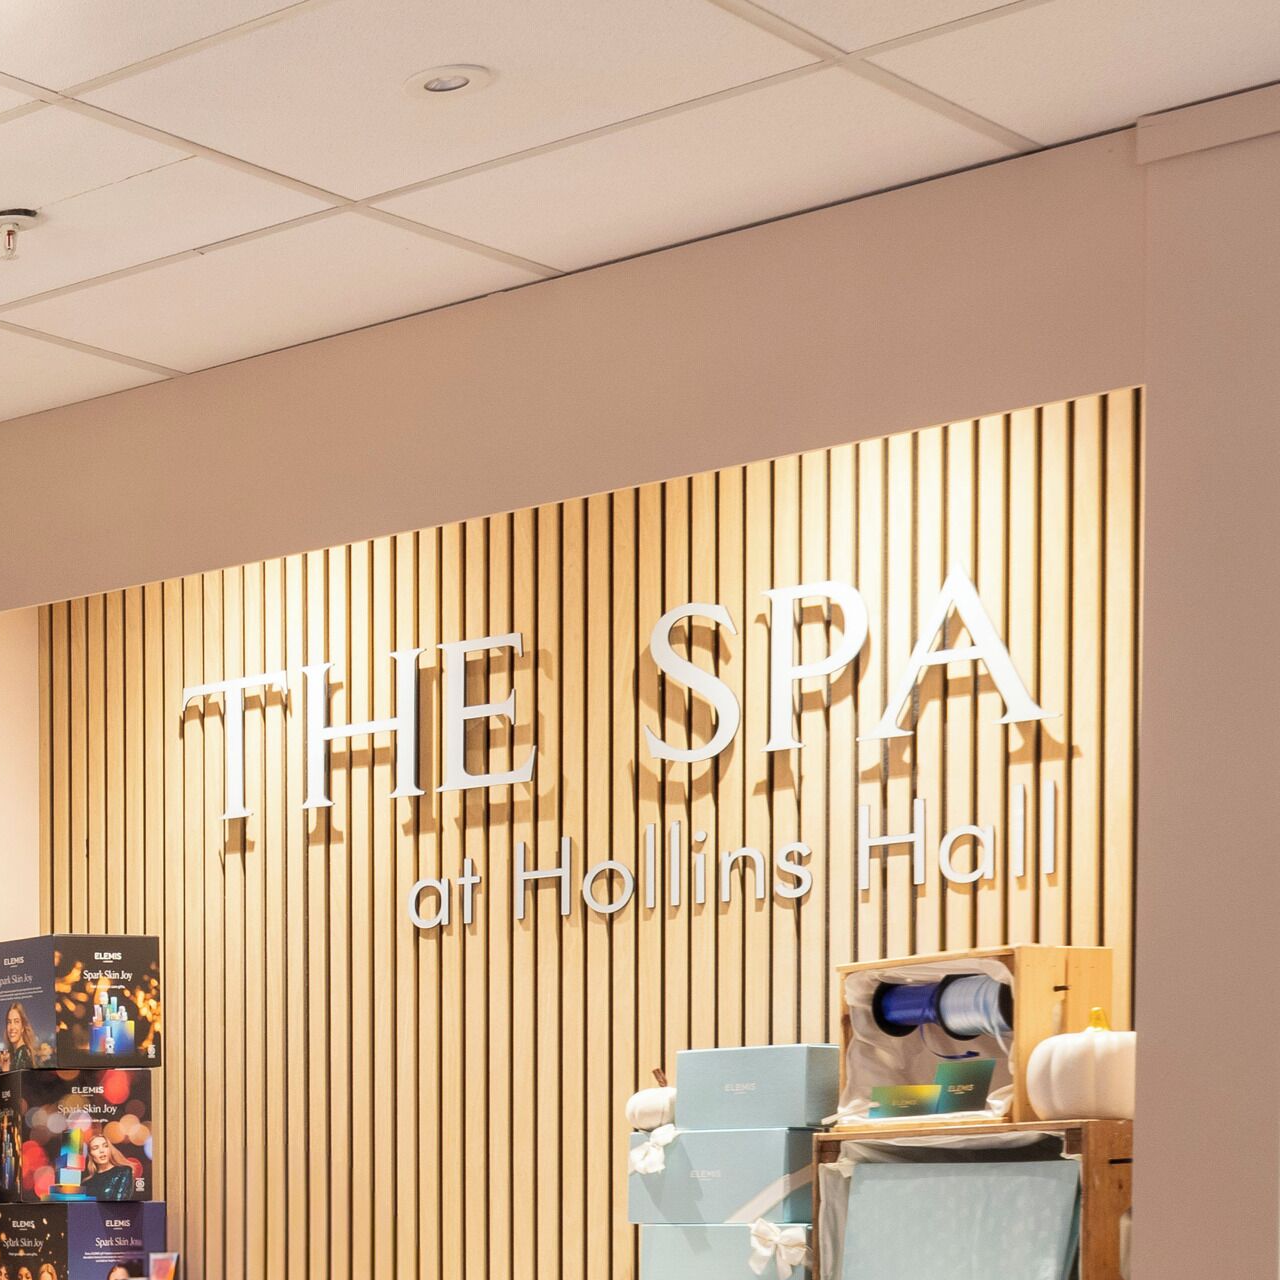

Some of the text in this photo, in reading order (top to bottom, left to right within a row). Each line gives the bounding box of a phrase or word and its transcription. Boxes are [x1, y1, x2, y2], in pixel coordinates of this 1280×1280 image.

[182, 562, 1063, 820] THE SPA
[407, 780, 1055, 930] at Hollins Hall
[3, 956, 25, 966] ELEMIS
[94, 952, 123, 961] ELEMIS
[11, 974, 23, 984] Skin
[23, 973, 33, 983] Joy
[83, 970, 133, 982] Spark Skin Joy
[71, 1086, 105, 1094] ELEMIS
[724, 1083, 757, 1092] ELEMIS
[57, 1103, 118, 1116] Spark Skin Joy
[690, 1169, 721, 1178] ELEMIS
[12, 1220, 35, 1229] ELEMIS
[105, 1219, 131, 1228] ELEMIS
[3, 1237, 44, 1250] Spark Skin Joy
[95, 1237, 114, 1248] Spark
[114, 1237, 129, 1246] Skin
